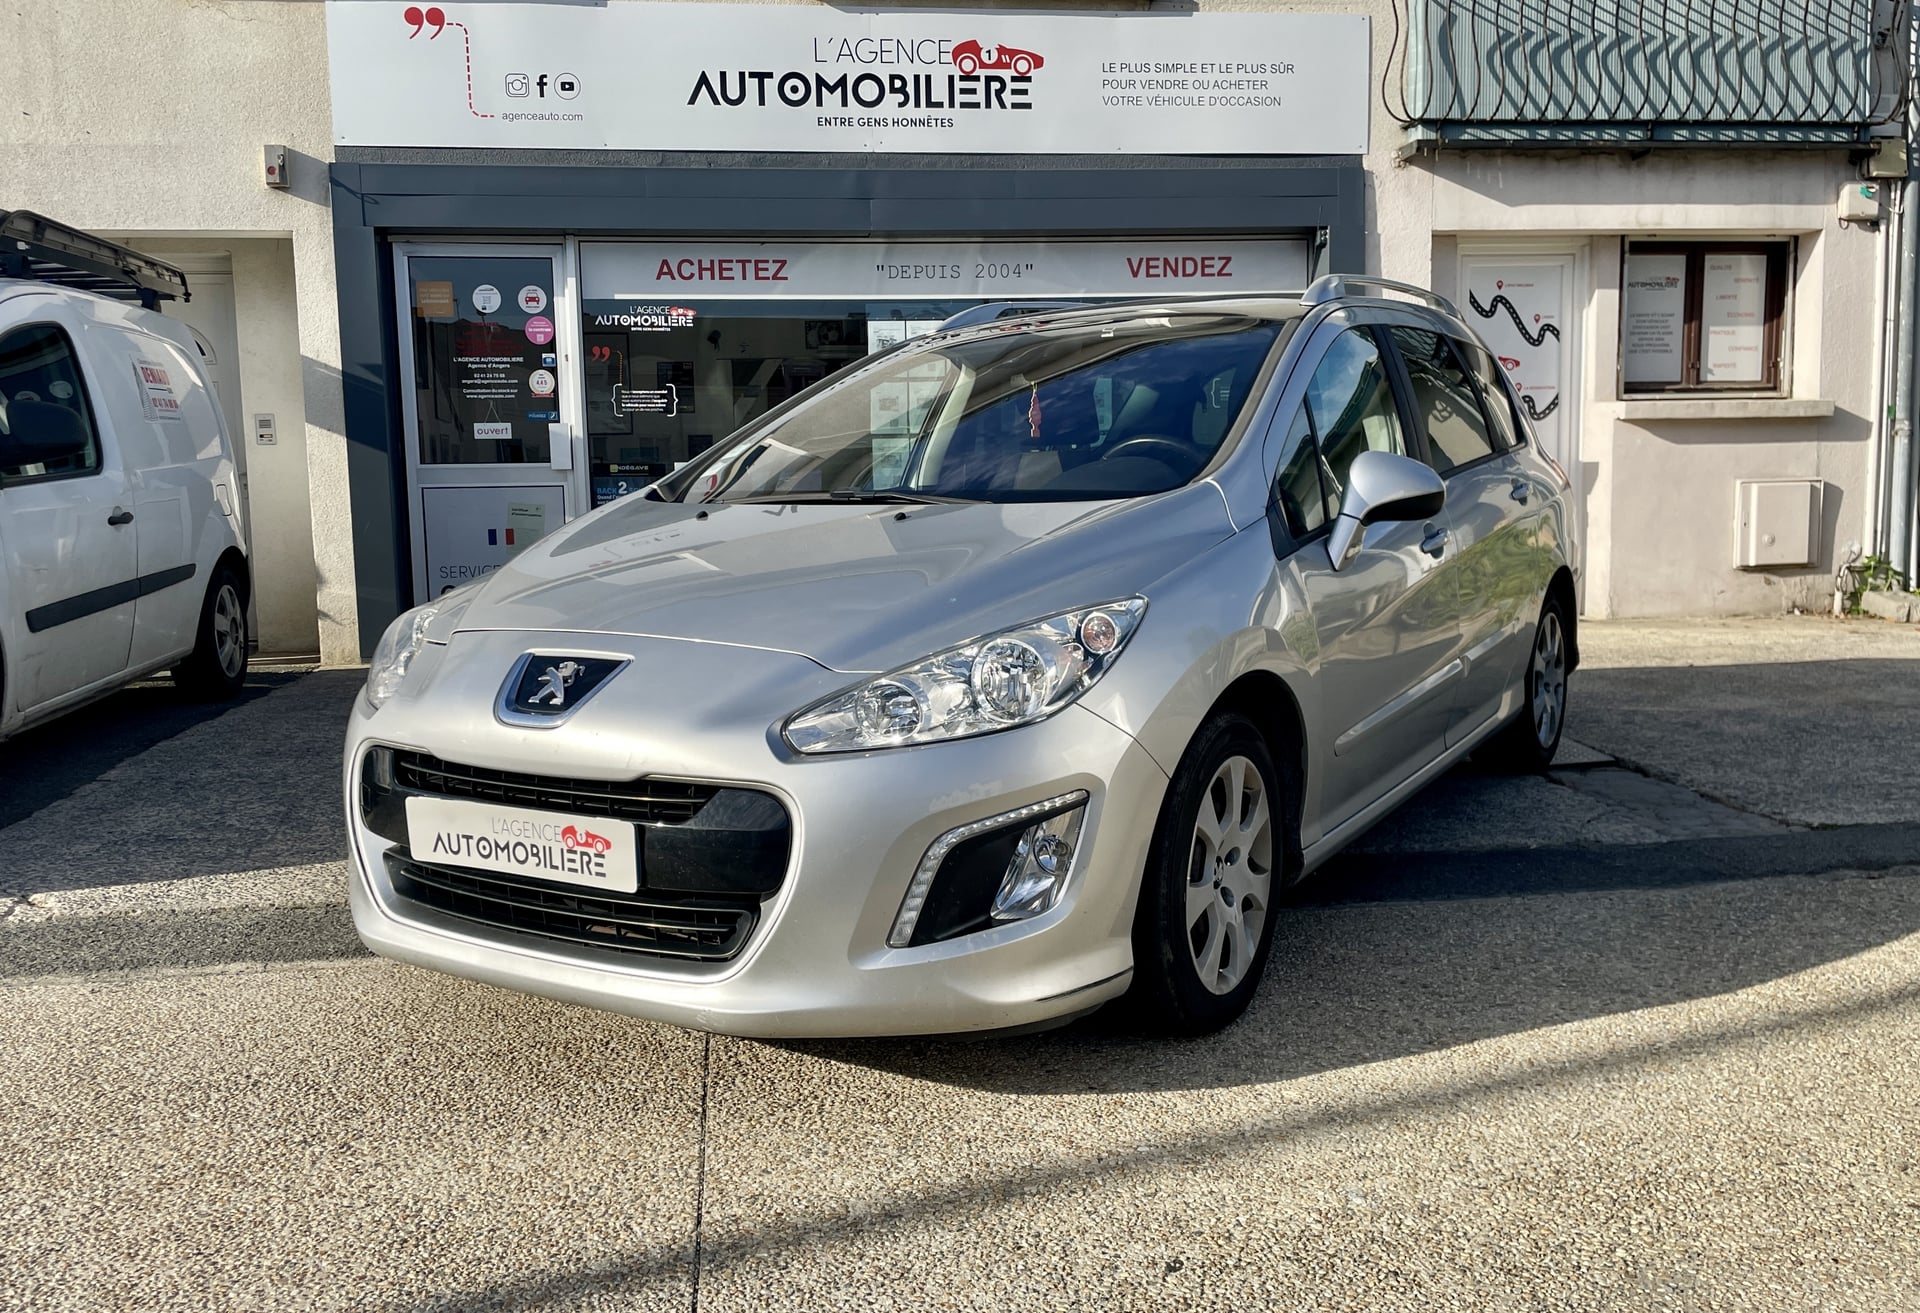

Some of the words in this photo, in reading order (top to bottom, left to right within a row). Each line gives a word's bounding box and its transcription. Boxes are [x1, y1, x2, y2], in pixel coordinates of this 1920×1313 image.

[813, 37, 953, 65] L'AGENCE
[1102, 63, 1117, 73] LE
[1120, 63, 1151, 73] PLUS
[1154, 63, 1198, 73] SIMPLE
[1201, 63, 1216, 73] ET
[1219, 63, 1233, 73] LE
[1236, 63, 1267, 74] PLUS
[1270, 61, 1295, 74] SÛR
[1102, 79, 1137, 89] POUR
[1140, 79, 1189, 90] VENDRE
[1192, 79, 1210, 90] OU
[1212, 79, 1269, 90] ACHETER
[1102, 96, 1143, 106] VOTRE
[1146, 94, 1206, 107] VÉHICULE
[1208, 96, 1282, 107] D'OCCASION
[502, 112, 583, 122] agenceauto.com
[817, 117, 854, 127] ENTRE
[857, 117, 889, 127] GENS
[892, 115, 954, 128] HONNÊTES
[656, 258, 789, 281] ACHETEZ
[1126, 256, 1233, 278] VENDEZ
[630, 305, 670, 315] L'AGENCE
[477, 426, 509, 436] ouvert
[618, 481, 628, 495] 2
[492, 817, 562, 844] L'AGENCE
